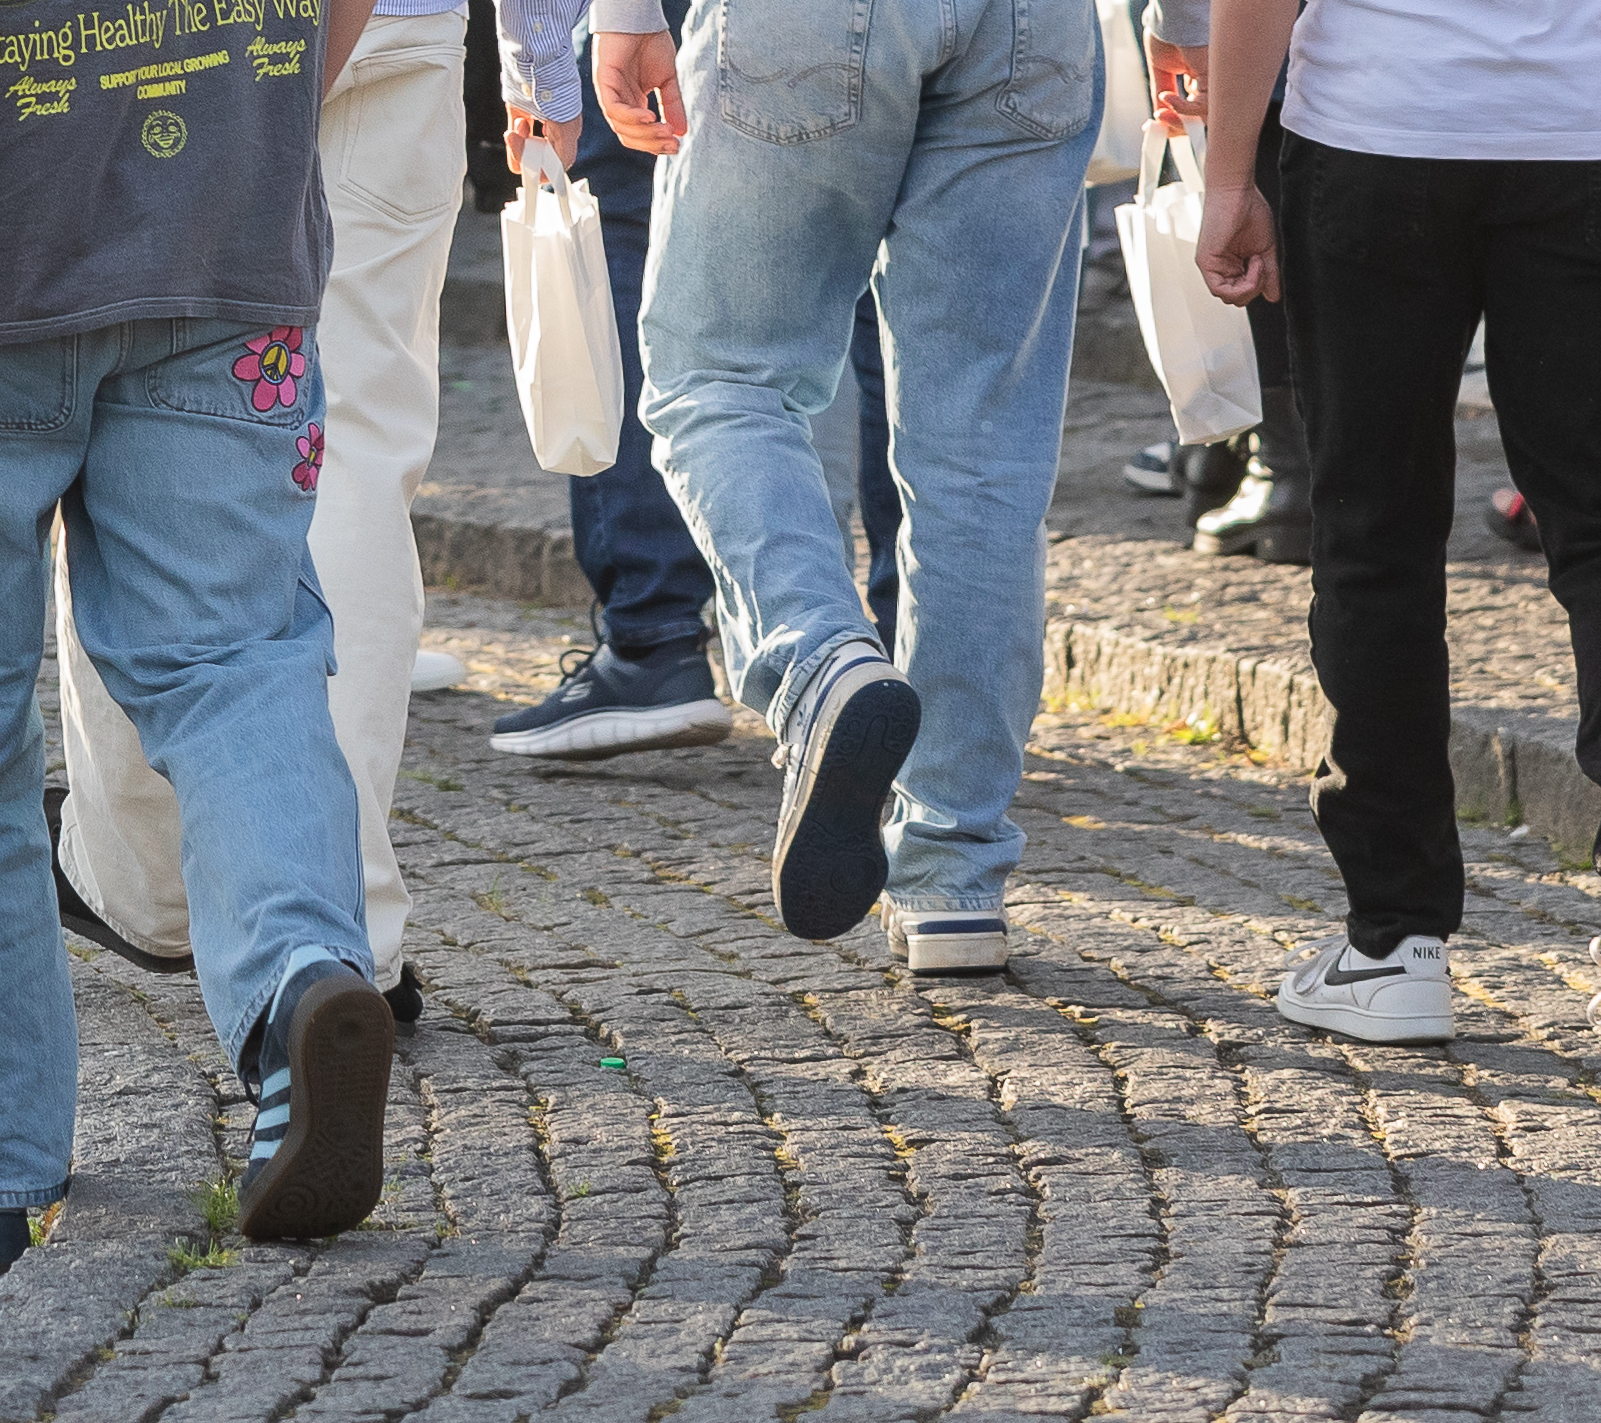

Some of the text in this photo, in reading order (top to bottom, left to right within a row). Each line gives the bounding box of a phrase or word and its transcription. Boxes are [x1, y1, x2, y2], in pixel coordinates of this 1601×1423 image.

[77, 0, 168, 53] Healthy
[245, 35, 308, 59] Always
[158, 60, 185, 77] LOCAL
[183, 49, 230, 73] GROWING
[252, 54, 301, 82] Fresh
[4, 75, 77, 99] Always
[16, 92, 71, 122] Fresh
[1412, 946, 1441, 960] NIKE
